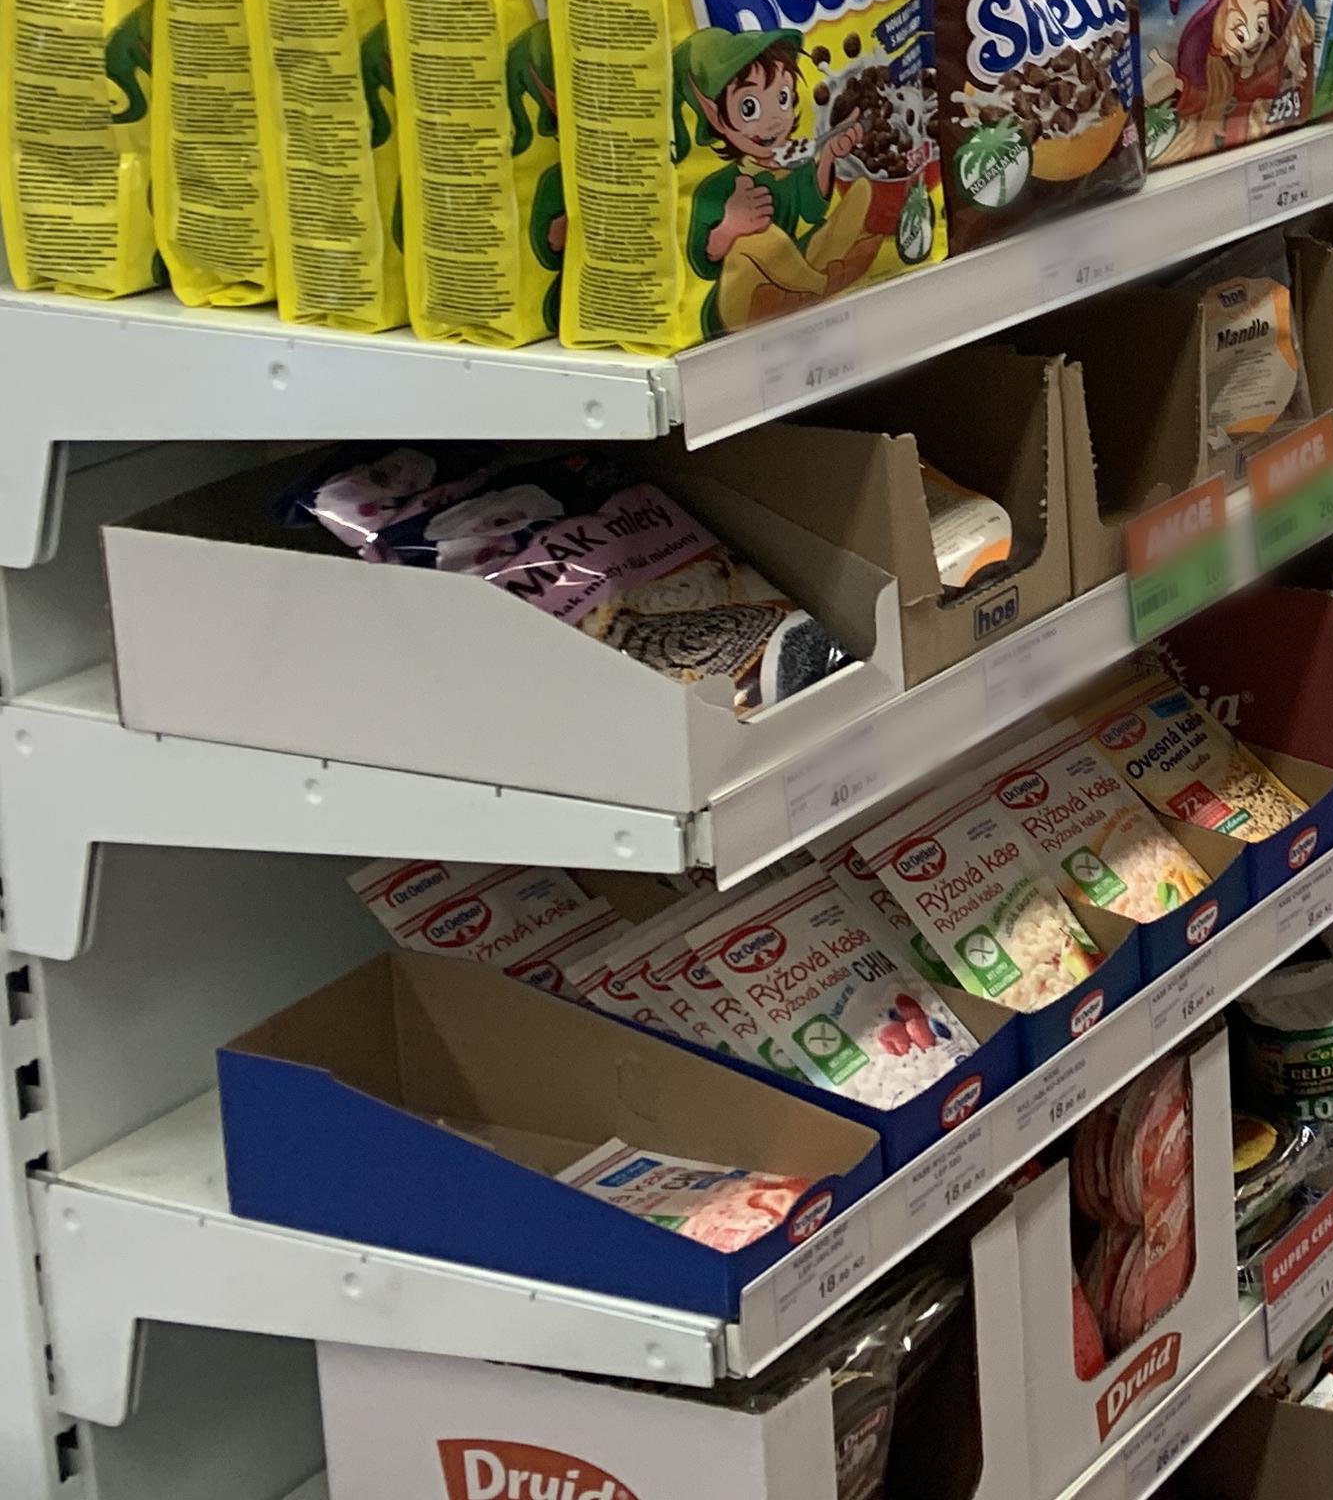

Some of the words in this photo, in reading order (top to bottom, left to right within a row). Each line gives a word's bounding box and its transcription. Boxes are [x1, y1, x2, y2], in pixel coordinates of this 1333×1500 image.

[969, 181, 986, 195] NO
[984, 158, 1014, 184] PALM
[1008, 144, 1029, 162] OIL
[1216, 319, 1270, 352] Mandle
[505, 524, 607, 600] MÁK
[604, 500, 674, 541] mletý
[1125, 729, 1181, 781] Ovesná
[1176, 712, 1207, 736] kaše
[1001, 775, 1044, 804] Dr.Oetker
[1021, 796, 1084, 841] Rýžová
[1084, 774, 1122, 802] kaše
[898, 843, 940, 874] Dr.Oetker
[914, 861, 985, 917] Rýžová
[985, 841, 1020, 869] kaše
[728, 929, 778, 965] Dr.Oetker
[746, 944, 830, 1008] Rýžová
[830, 928, 871, 955] kaše
[850, 950, 898, 983] CHIA
[1270, 1238, 1310, 1283] SUPER
[1106, 1341, 1173, 1424] Druid
